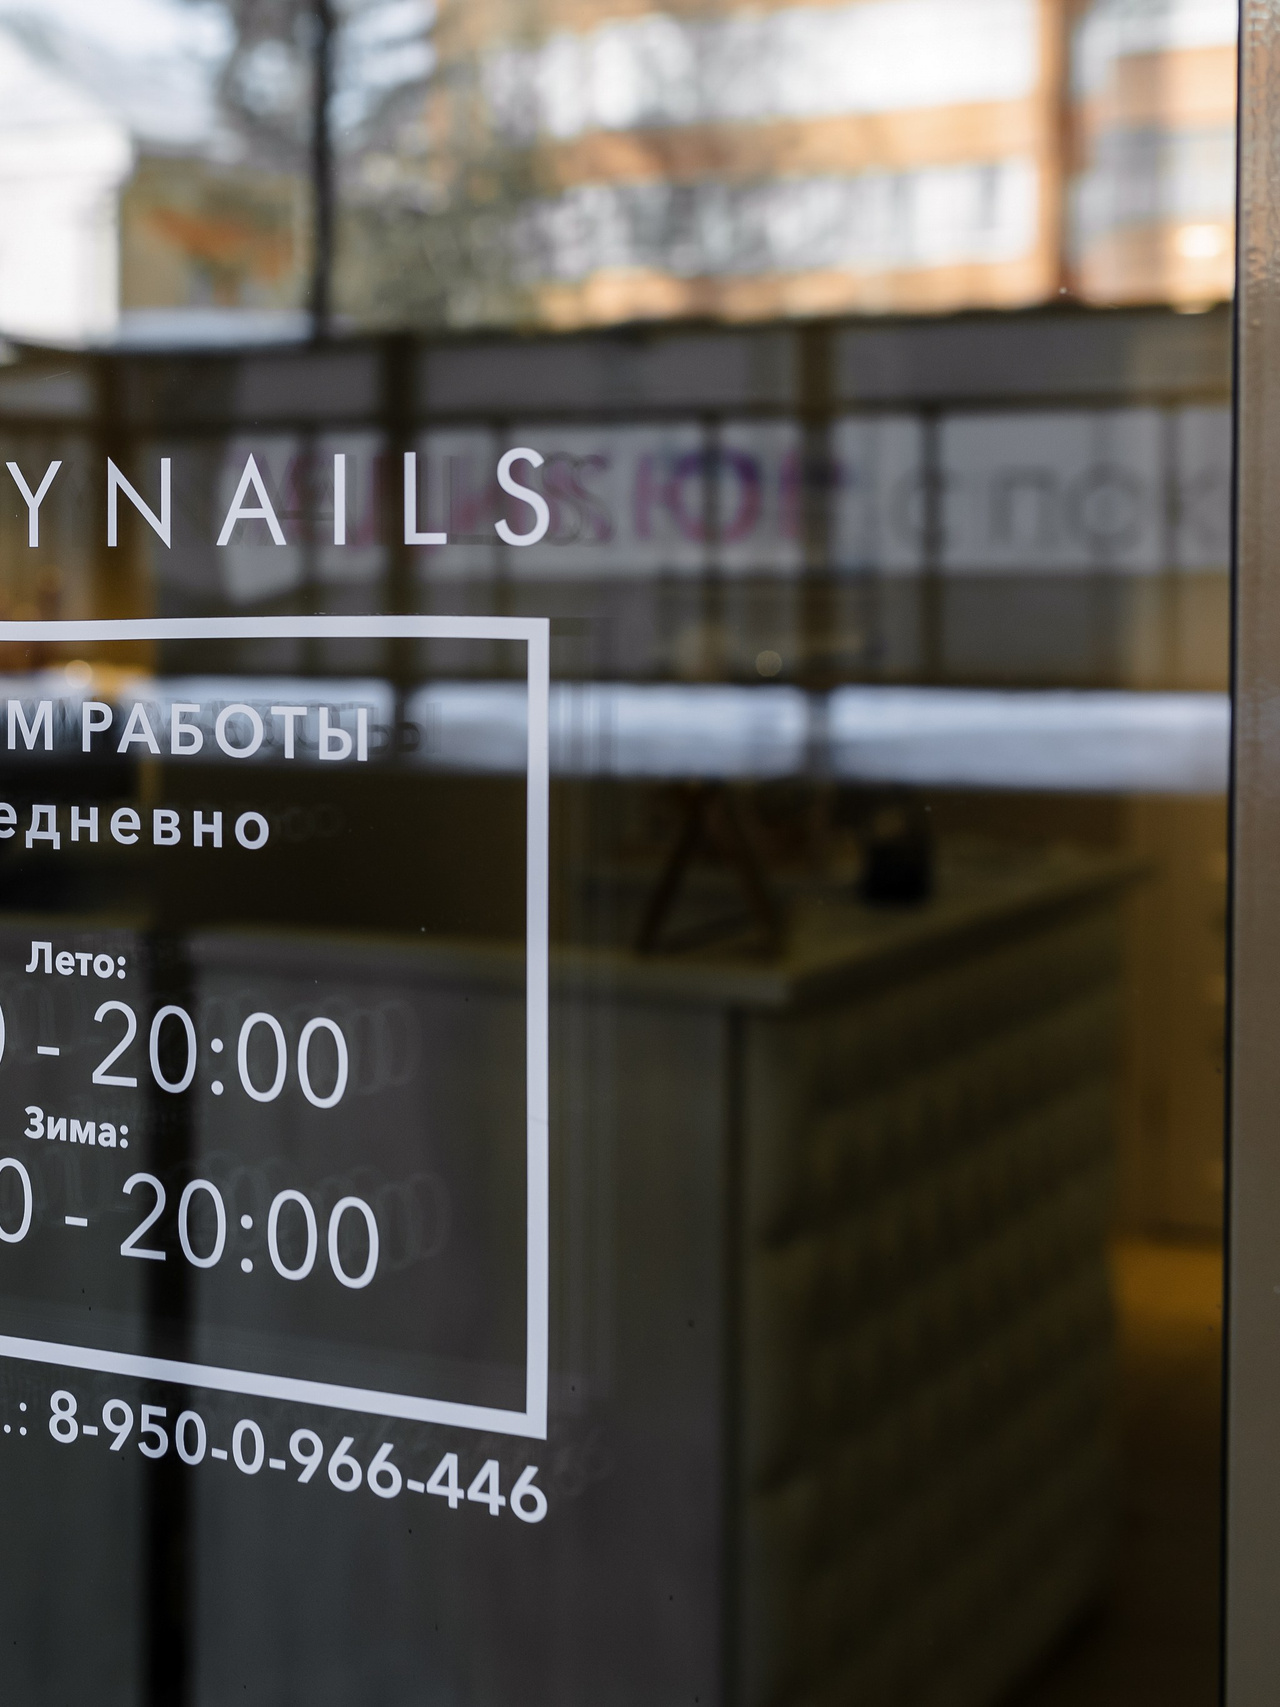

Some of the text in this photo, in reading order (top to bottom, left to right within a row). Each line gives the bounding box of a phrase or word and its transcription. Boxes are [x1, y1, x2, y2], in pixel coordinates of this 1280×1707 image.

[81, 702, 370, 762] РАБОТЫ
[25, 941, 127, 980] Лето:
[91, 1000, 349, 1109] 20:00
[24, 1105, 130, 1149] Зима:
[119, 1173, 380, 1289] 20:00
[48, 1388, 549, 1524] 8-950-0-966-446
